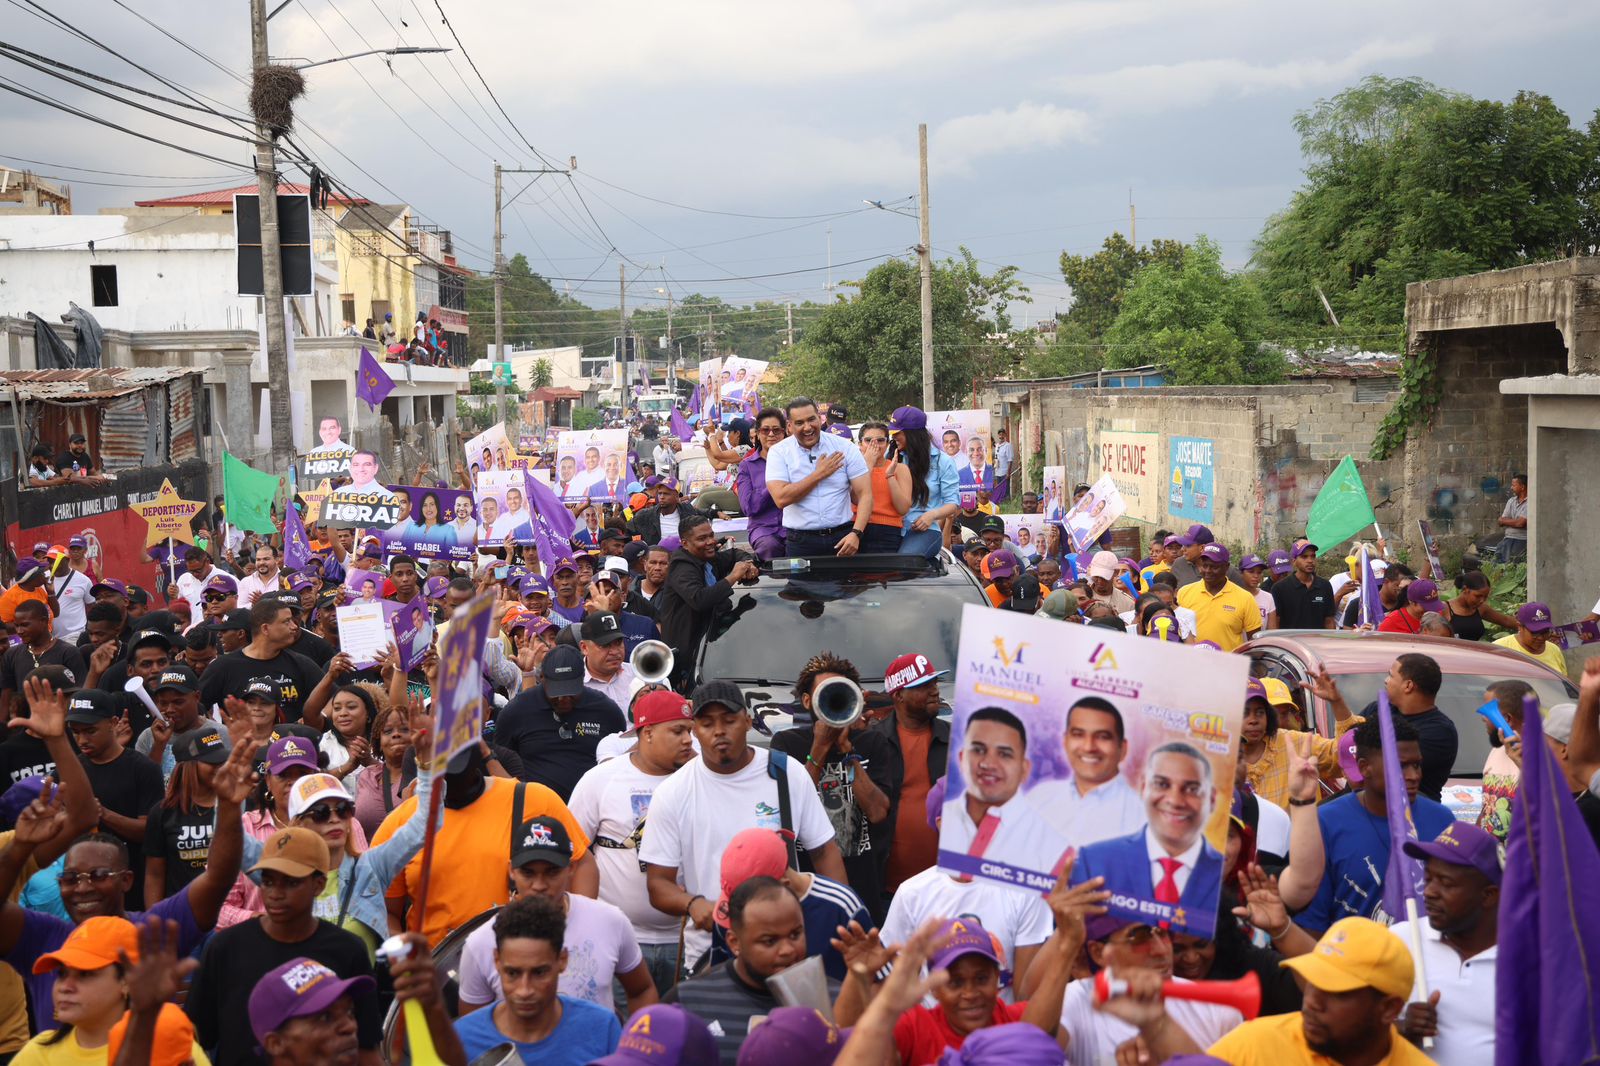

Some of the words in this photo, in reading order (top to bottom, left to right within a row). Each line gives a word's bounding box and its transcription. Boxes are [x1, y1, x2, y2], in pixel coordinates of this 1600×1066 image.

[306, 447, 343, 463] ¡LLEGÓ
[1102, 442, 1113, 473] SE
[1115, 443, 1146, 477] VENDE
[329, 490, 379, 506] ¡LLEGÓ
[382, 496, 400, 506] LA
[53, 503, 76, 521] CHARLY
[76, 502, 81, 517] Y
[82, 498, 102, 516] MANUEL
[104, 495, 118, 512] AUTO
[143, 504, 196, 517] DEPORTISTAS
[414, 543, 441, 553] ISABEL
[970, 661, 1045, 687] MANUEL
[1093, 674, 1144, 689] ALBERTO
[575, 721, 601, 731] ARMANI
[980, 863, 1014, 880] CIRC.
[1016, 871, 1025, 883] 3
[1026, 873, 1057, 891] SANT
[1139, 899, 1172, 918] ESTE
